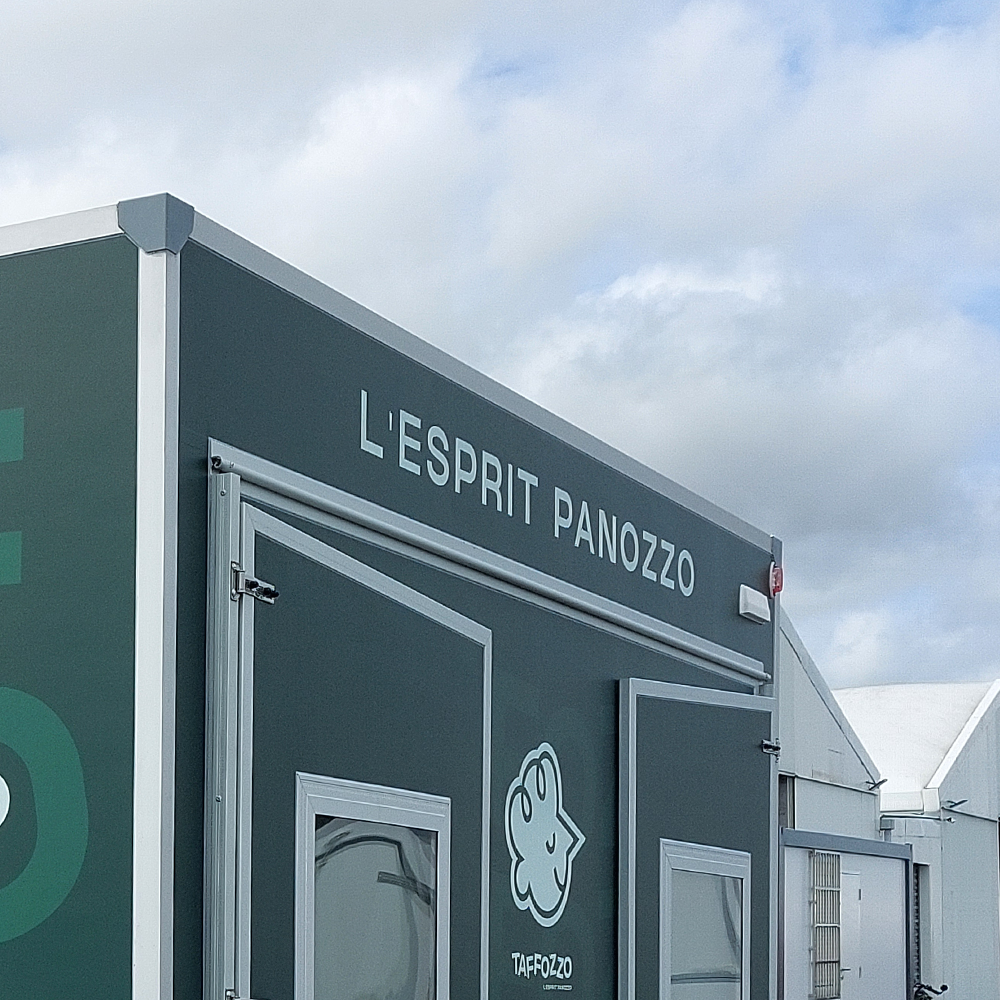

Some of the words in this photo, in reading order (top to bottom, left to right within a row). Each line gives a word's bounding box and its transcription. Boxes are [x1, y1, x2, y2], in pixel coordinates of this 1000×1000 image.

[361, 389, 539, 525] L'ESPRIT
[555, 486, 696, 597] PANOZZO
[511, 952, 573, 979] TAFFOZZO
